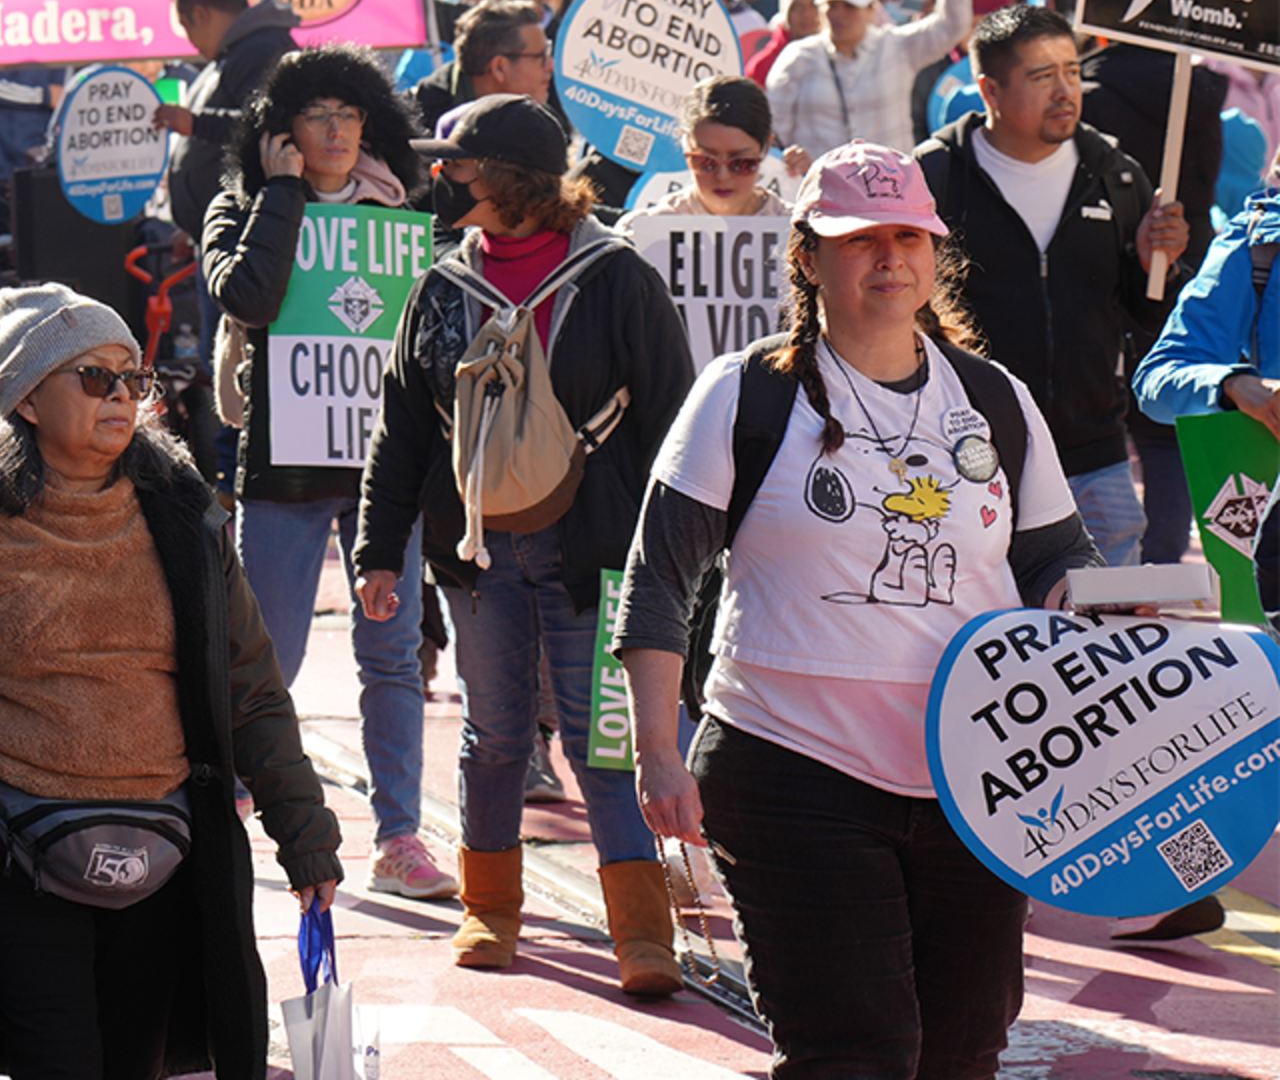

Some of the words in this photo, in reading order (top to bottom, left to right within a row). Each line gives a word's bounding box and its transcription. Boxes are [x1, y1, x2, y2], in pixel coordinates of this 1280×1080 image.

[582, 18, 724, 84] ABORTIO
[665, 13, 722, 57] END
[78, 107, 101, 127] TO
[105, 104, 147, 125] END
[88, 80, 134, 103] PRAY
[66, 126, 160, 153] ABORTION
[295, 216, 359, 272] OVE
[366, 218, 426, 279] LIFE
[669, 230, 778, 300] ELIGE
[290, 341, 392, 401] CHOO
[326, 405, 380, 461] LIF
[595, 666, 631, 760] LOVE
[970, 681, 1049, 744] TO
[1052, 622, 1171, 696] END
[979, 637, 1240, 817] ABORTION
[1023, 817, 1068, 861] 40
[1063, 770, 1140, 834] DAYS
[1132, 733, 1204, 789] FOR
[1192, 691, 1267, 758] LIFE
[1049, 738, 1280, 899] 40DaysForLife.com
